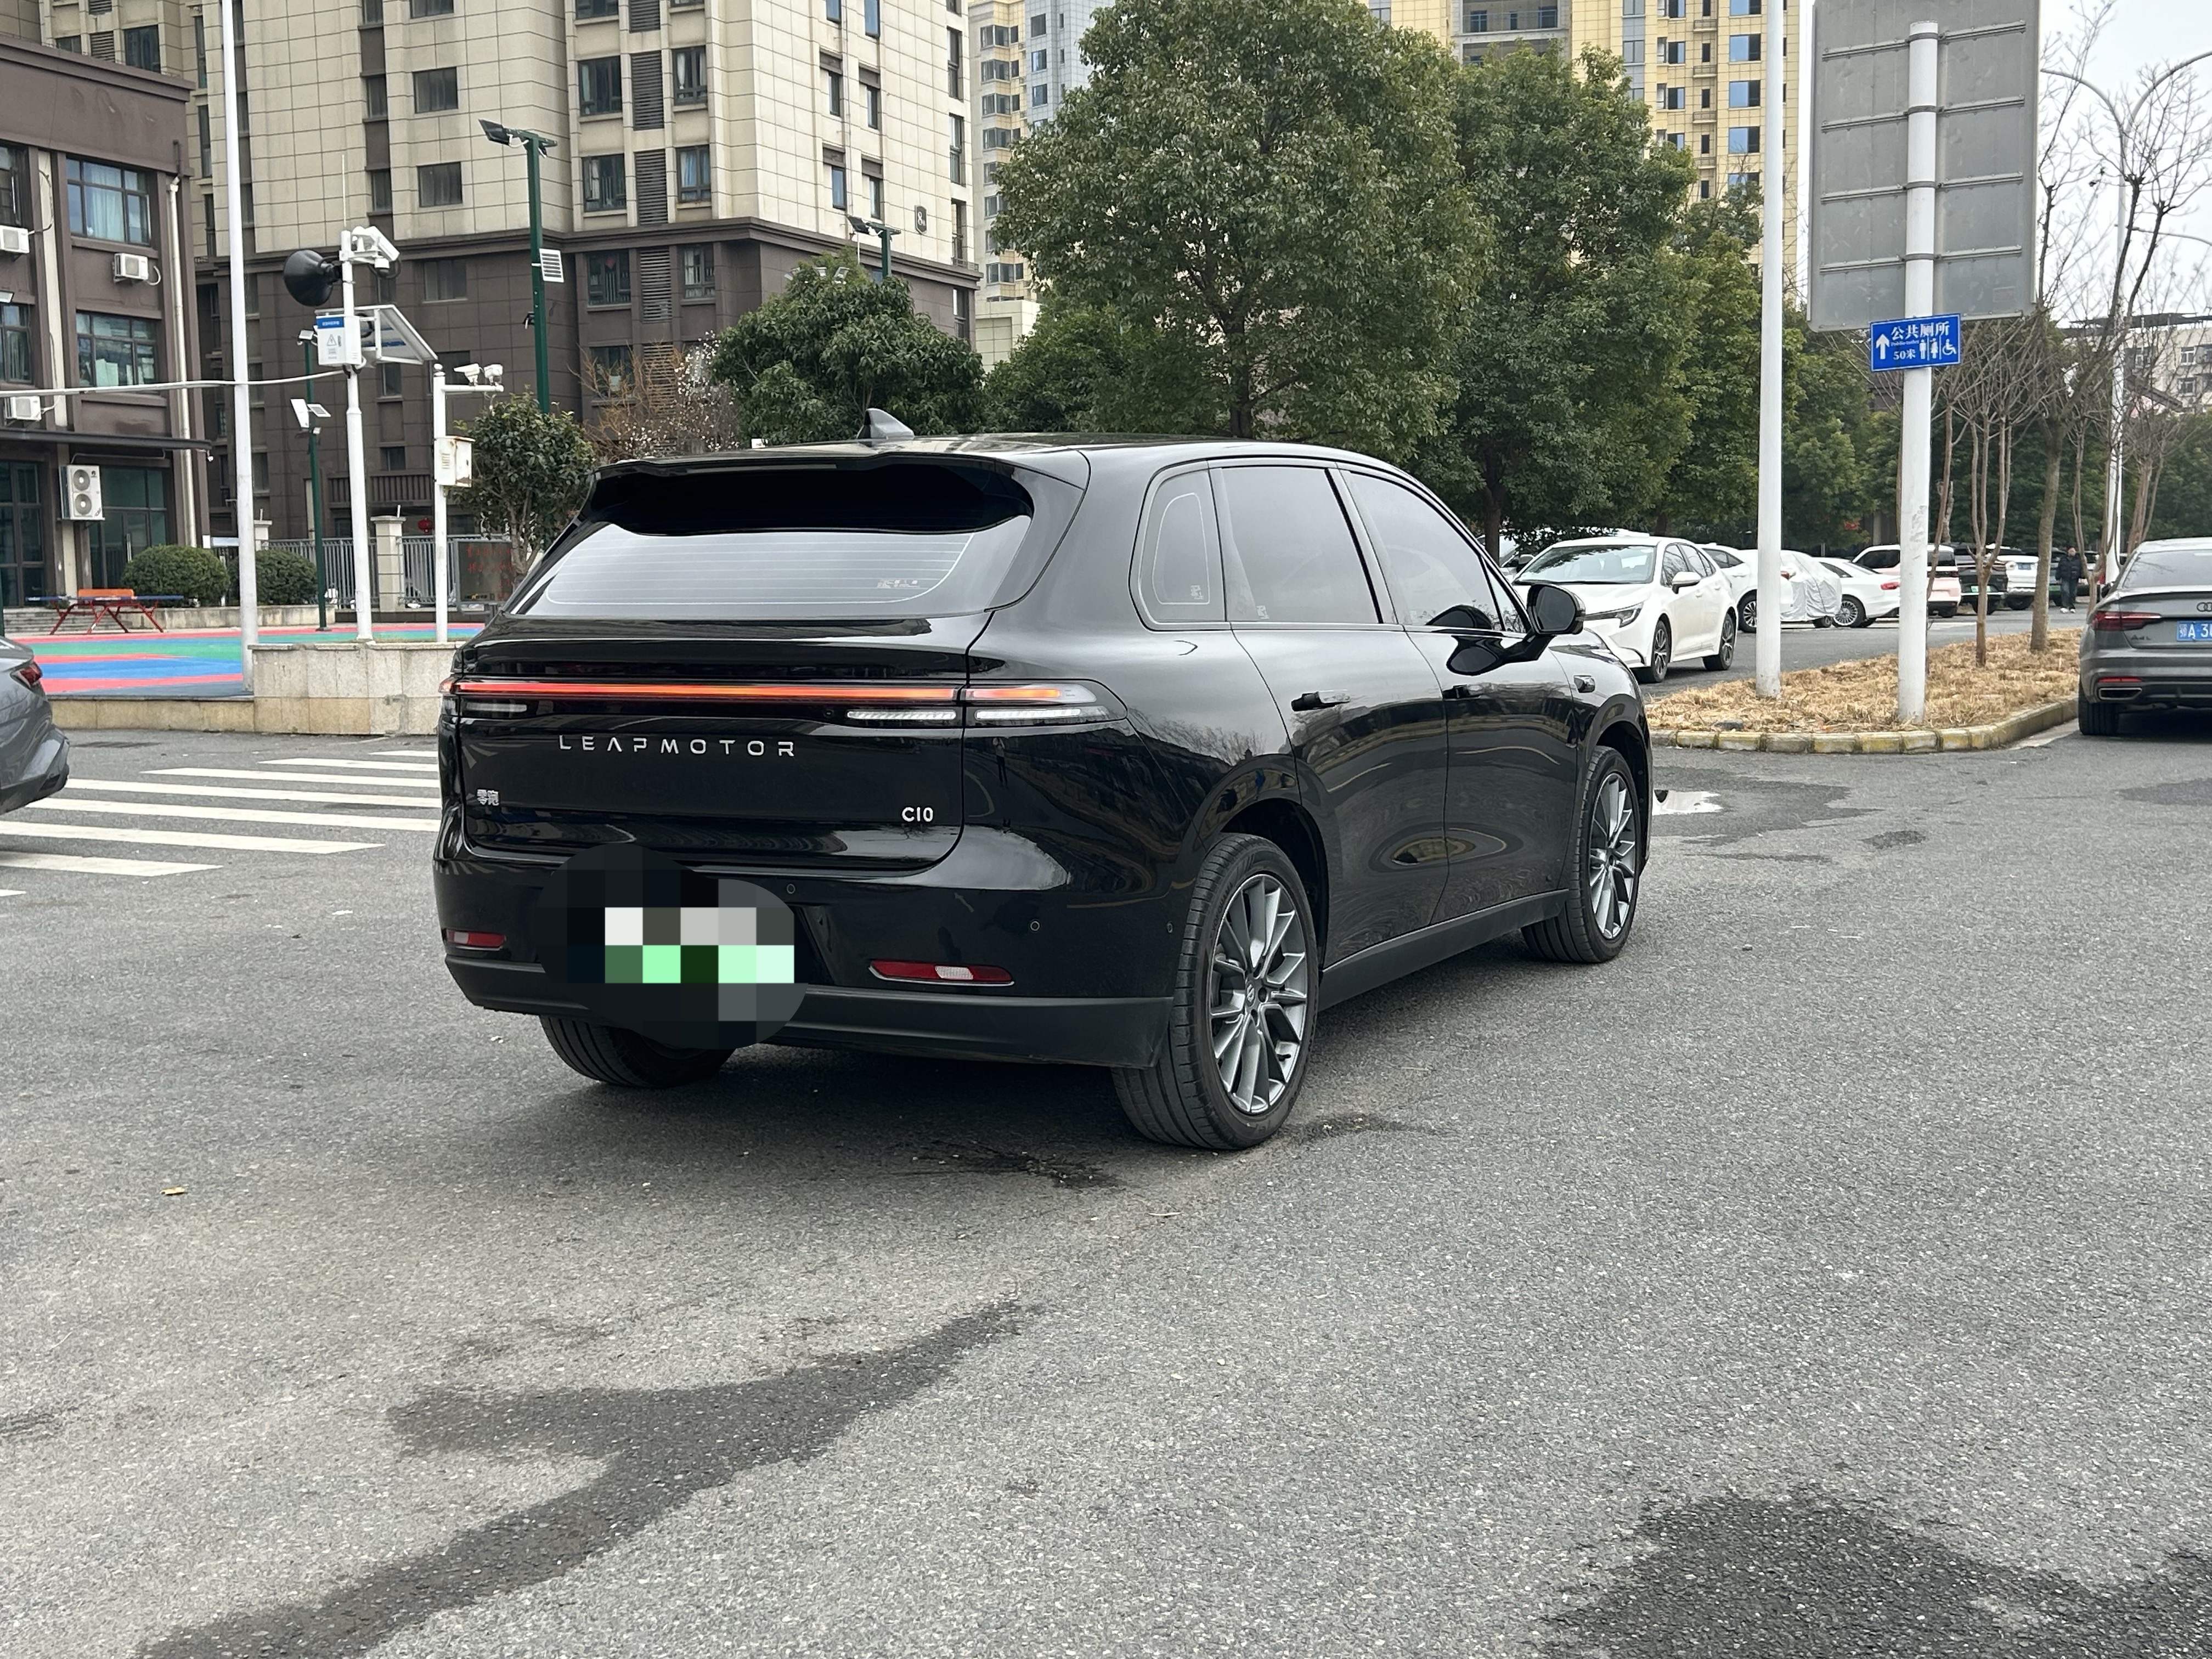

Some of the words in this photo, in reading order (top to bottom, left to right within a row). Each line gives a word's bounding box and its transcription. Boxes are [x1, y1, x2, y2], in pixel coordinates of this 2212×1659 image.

[1891, 321, 1949, 340] 公共厕所
[1893, 349, 1916, 360] 50米
[559, 735, 795, 757] LEAPMOTOR
[477, 789, 499, 806] 零跑
[902, 808, 933, 822] C10
